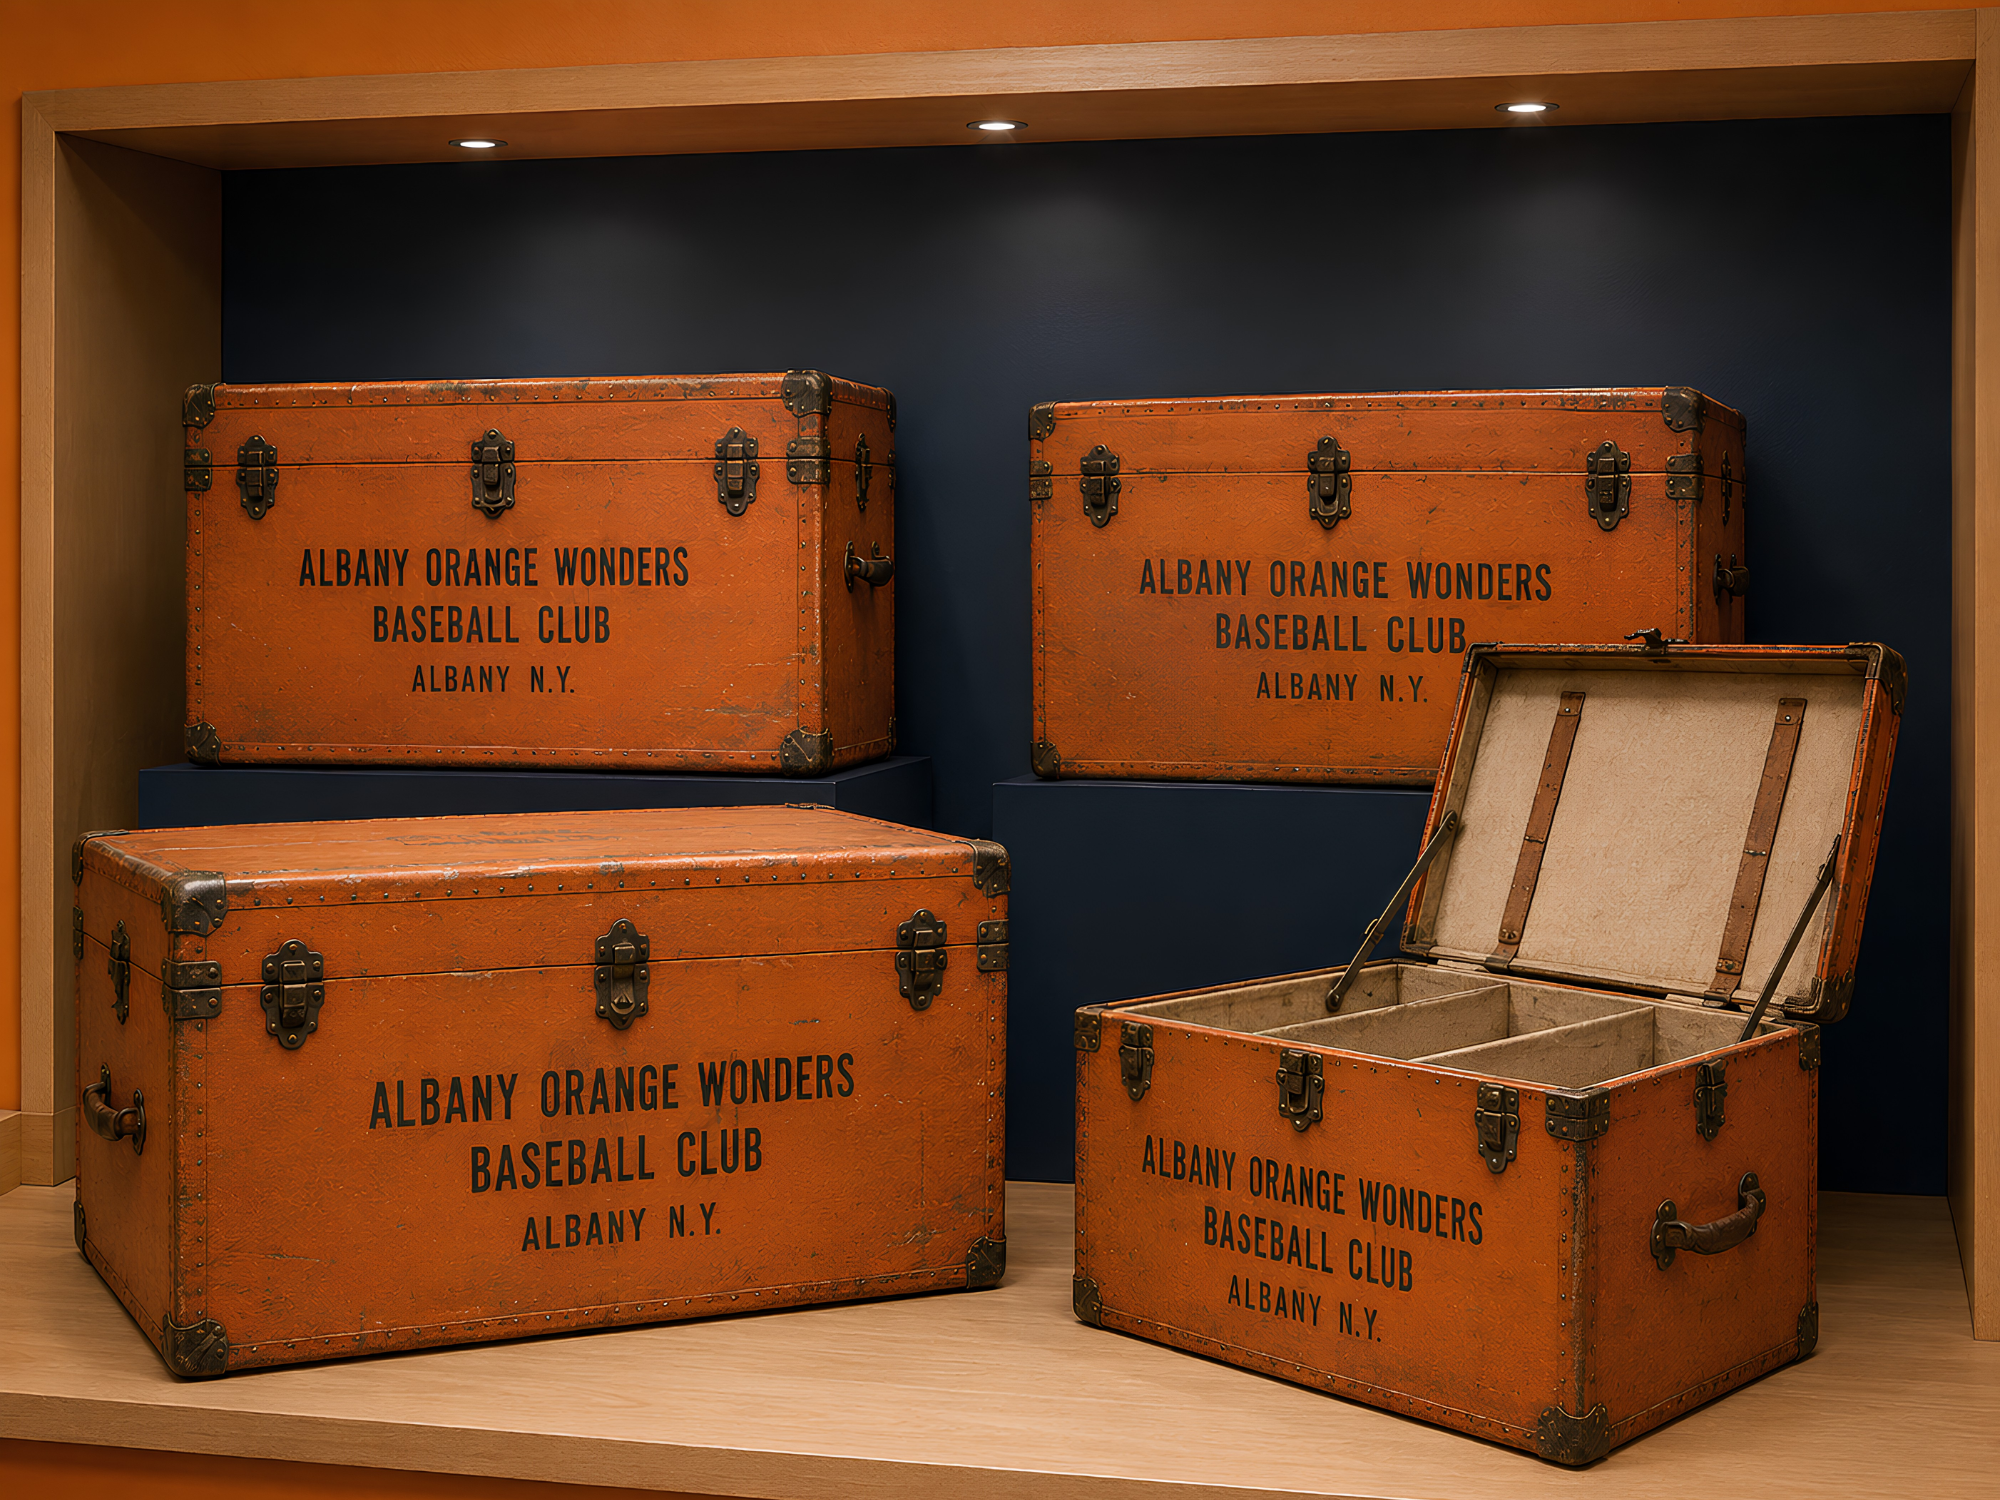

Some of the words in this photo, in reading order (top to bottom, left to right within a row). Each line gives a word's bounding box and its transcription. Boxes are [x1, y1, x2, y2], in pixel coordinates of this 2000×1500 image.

[300, 549, 409, 586] ALBANY
[427, 548, 538, 586] ORANGE
[554, 547, 688, 586] WONDERS
[1140, 559, 1250, 595] ALBANY
[1271, 561, 1388, 598] ORANGE
[1407, 562, 1551, 601] WONDERS
[374, 606, 519, 643] BASEBALL
[539, 606, 610, 643] CLUB
[1216, 613, 1367, 651] BASEBALL
[1388, 616, 1467, 653] CLUB
[412, 665, 509, 692] ALBANY
[531, 666, 574, 693] N.Y.
[1257, 672, 1357, 701] ALBANY
[1381, 675, 1427, 702] N.Y.
[369, 1073, 518, 1129] ALBANY
[541, 1064, 678, 1117] ORANGE
[698, 1053, 854, 1106] WONDERS
[472, 1135, 654, 1193] BASEBALL
[678, 1128, 761, 1177] CLUB
[1142, 1135, 1235, 1191] ALBANY
[1250, 1156, 1345, 1215] ORANGE
[1359, 1178, 1482, 1245] WONDERS
[522, 1208, 646, 1251] ALBANY
[670, 1202, 720, 1238] N.Y.
[1205, 1206, 1333, 1273] BASEBALL
[1349, 1239, 1412, 1292] CLUB
[1228, 1275, 1321, 1326] ALBANY
[1340, 1302, 1381, 1342] N.Y.
